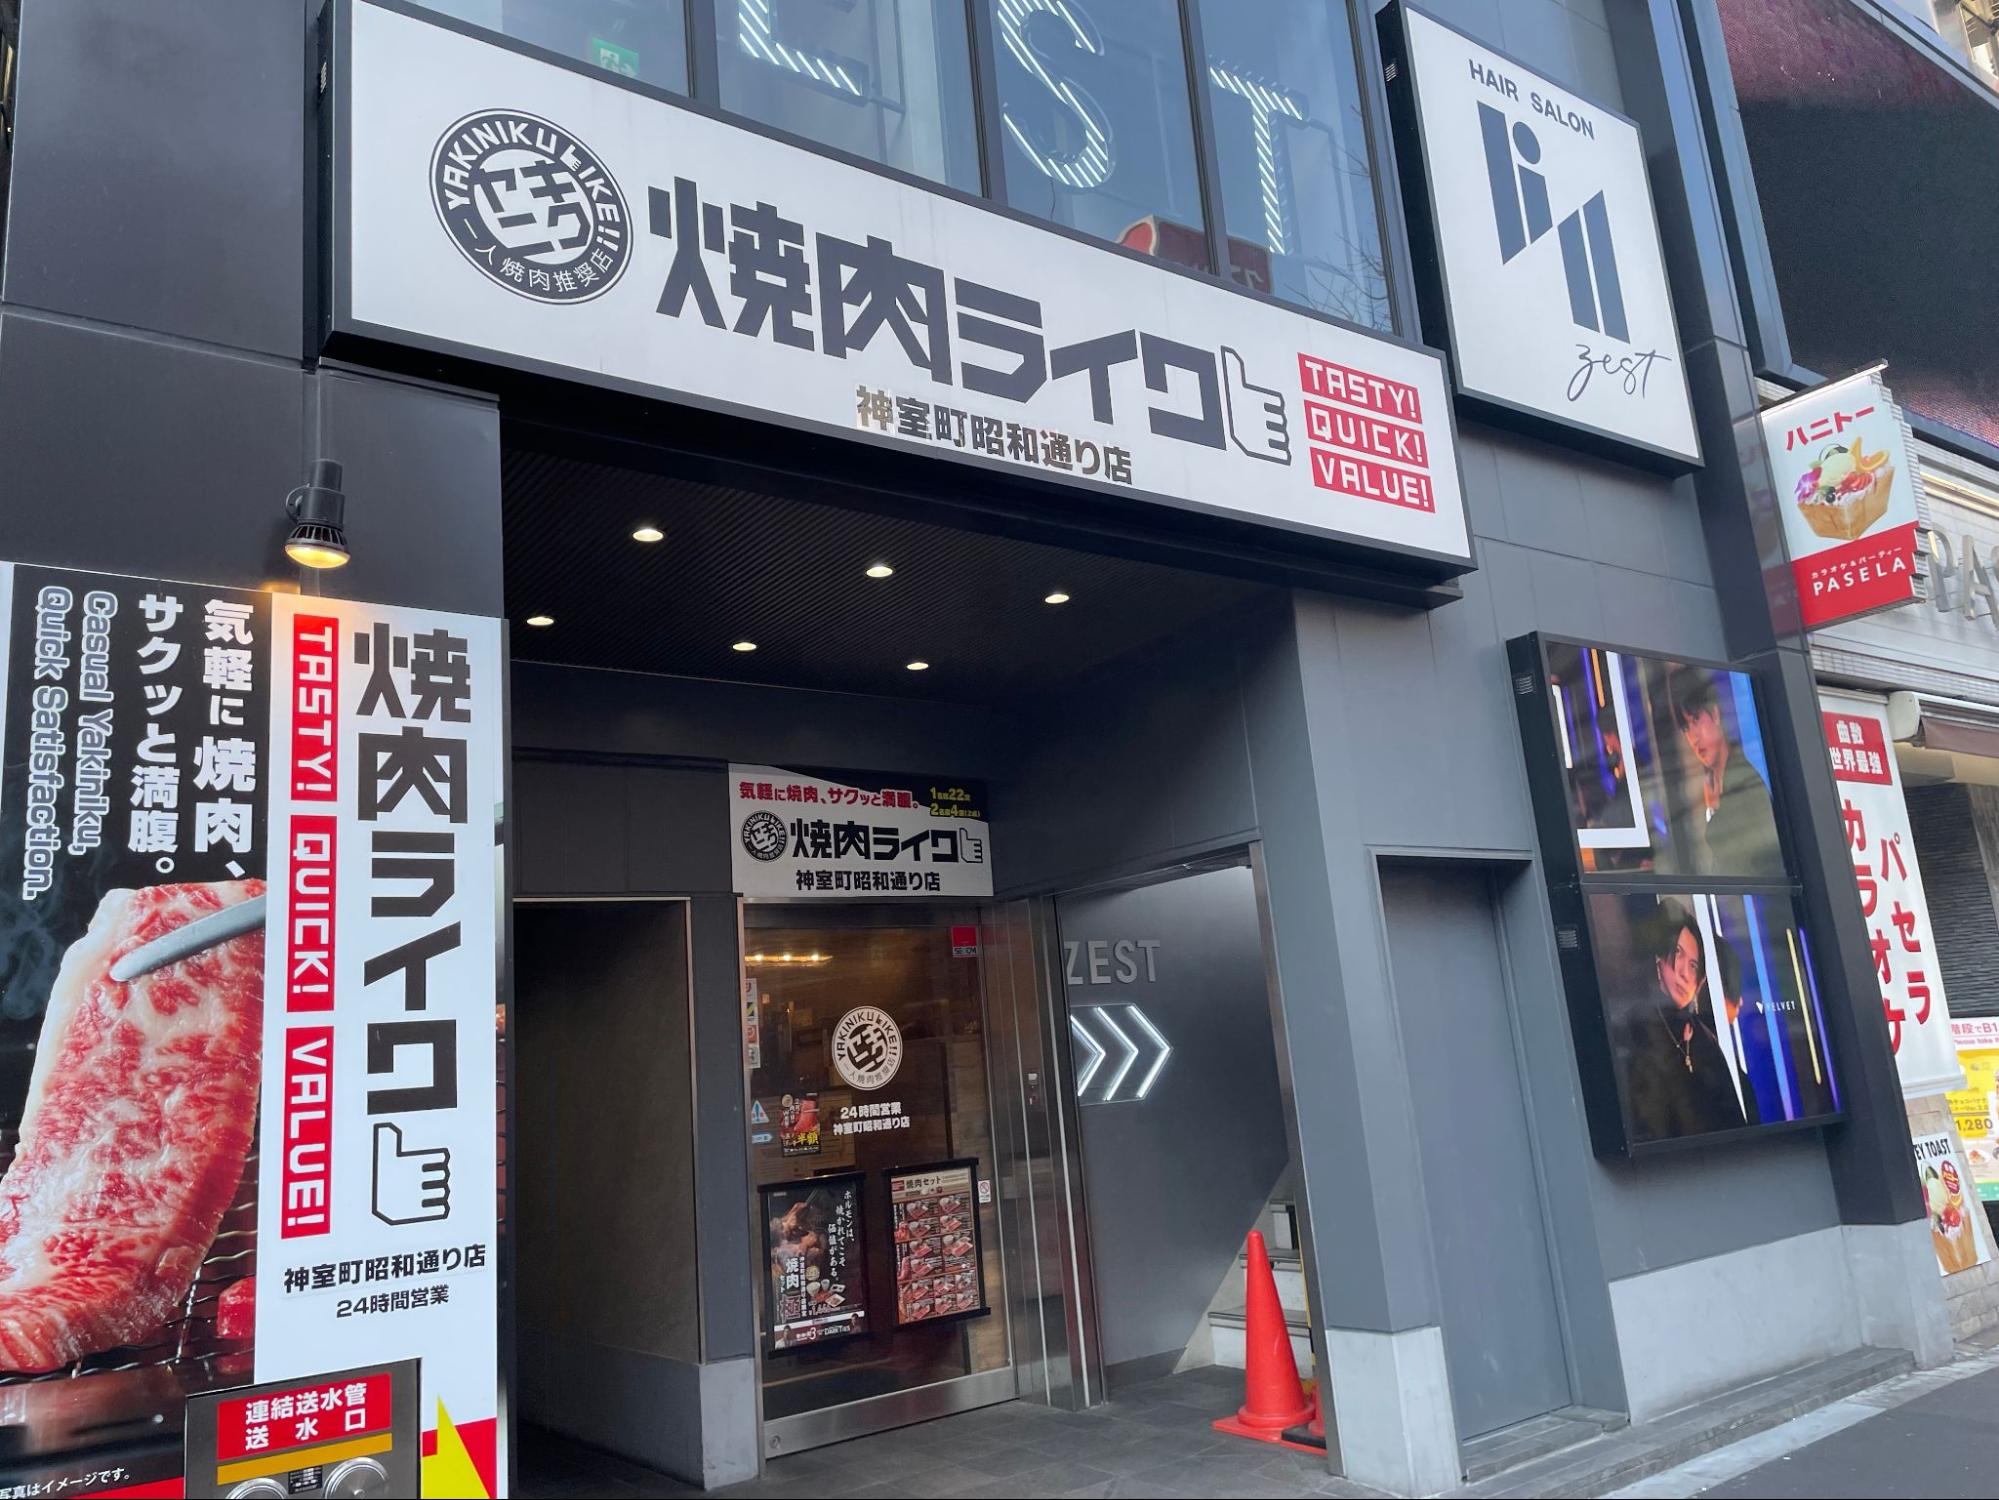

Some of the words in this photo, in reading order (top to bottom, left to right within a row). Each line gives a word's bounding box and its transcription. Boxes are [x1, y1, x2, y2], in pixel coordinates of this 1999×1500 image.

[1468, 58, 1520, 103] HAIR
[1530, 92, 1595, 141] SALON
[442, 119, 558, 211] YAKINIKU
[458, 219, 616, 294] 一人焼肉推奨店
[647, 175, 1228, 452] 焼肉ライク
[1303, 361, 1418, 419] TASTY!
[1566, 343, 1674, 402] zest
[855, 383, 1133, 486] 神室町昭和通り店
[1311, 407, 1425, 464] QUICK!
[1785, 405, 1875, 452] ハニトー
[1315, 453, 1431, 509] VALUE!
[1812, 556, 1907, 597] PASELA
[1928, 521, 1999, 634] PA
[33, 584, 74, 682] Quick
[78, 589, 119, 702] Casual
[127, 593, 184, 876] サクッと満腹。
[297, 626, 334, 793] TASTY!
[1836, 719, 1865, 746] 曲数
[194, 598, 257, 880] 気軽に焼肉、
[1829, 747, 1884, 776] 世界最強
[21, 685, 69, 901] Satisfaction.
[66, 707, 114, 857] Yakiniku,
[739, 781, 920, 810] 気軽に焼肉、サクッと満腹。
[353, 621, 472, 1116] 焼肉ライク
[789, 816, 960, 864] 焼肉ライク
[795, 869, 941, 892] 神室町昭和通り店
[290, 832, 332, 994] QUICK!
[1880, 831, 1932, 1025] パセラ
[1063, 939, 1161, 986] ZEST
[836, 1010, 874, 1061] YAKINIKU
[286, 1037, 330, 1228] VALUE!
[839, 1101, 902, 1119] 24時間営業
[1955, 1117, 1994, 1132] 1,280
[1924, 1137, 1951, 1158] TOAST
[283, 1242, 487, 1294] 神室町昭和通り店
[336, 1284, 449, 1319] 24時間営業
[244, 1382, 368, 1424] 連結送水管
